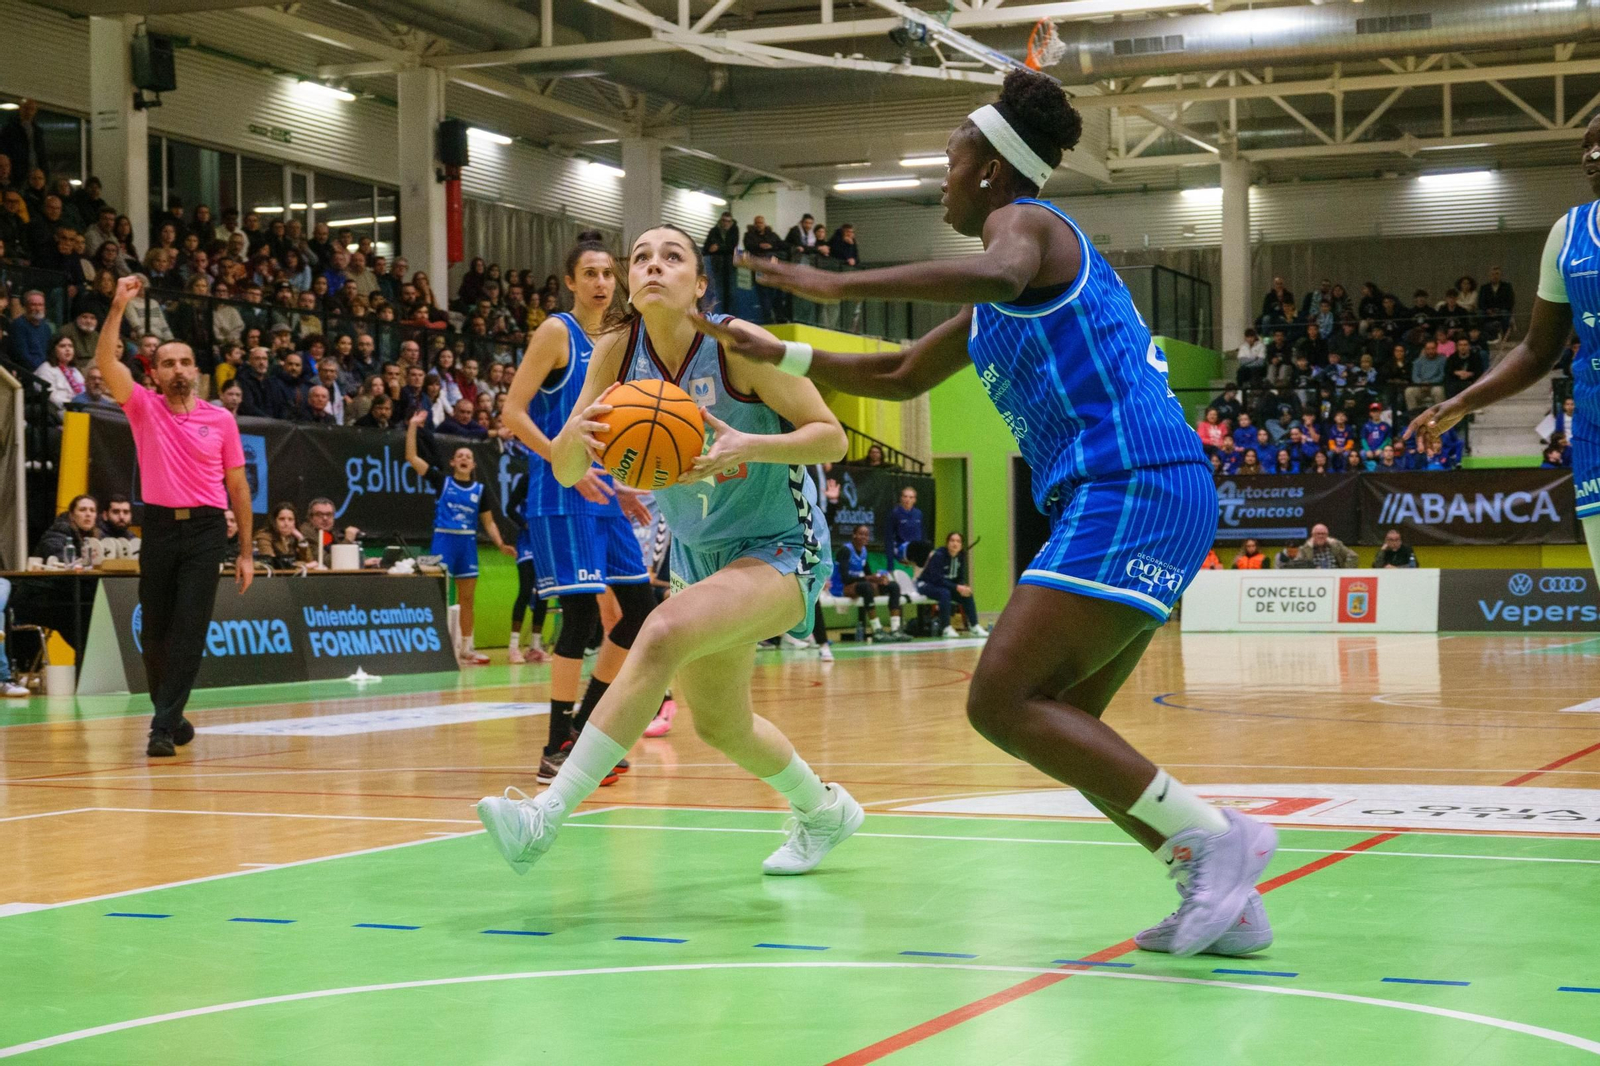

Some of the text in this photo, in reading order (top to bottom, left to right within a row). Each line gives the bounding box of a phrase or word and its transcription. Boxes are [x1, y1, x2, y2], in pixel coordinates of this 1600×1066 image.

[1217, 480, 1304, 499] Autocares
[1218, 499, 1304, 526] Troncoso
[1137, 552, 1184, 574] DECORACIONES
[1126, 558, 1183, 594] egea
[1247, 587, 1327, 598] CONCELLO
[303, 602, 434, 627] Uniendo caminos
[1256, 602, 1317, 613] DE VIGO
[1478, 600, 1600, 627] Vepers
[308, 626, 442, 658] FORMATIVOS
[1360, 808, 1600, 822] CELLO
